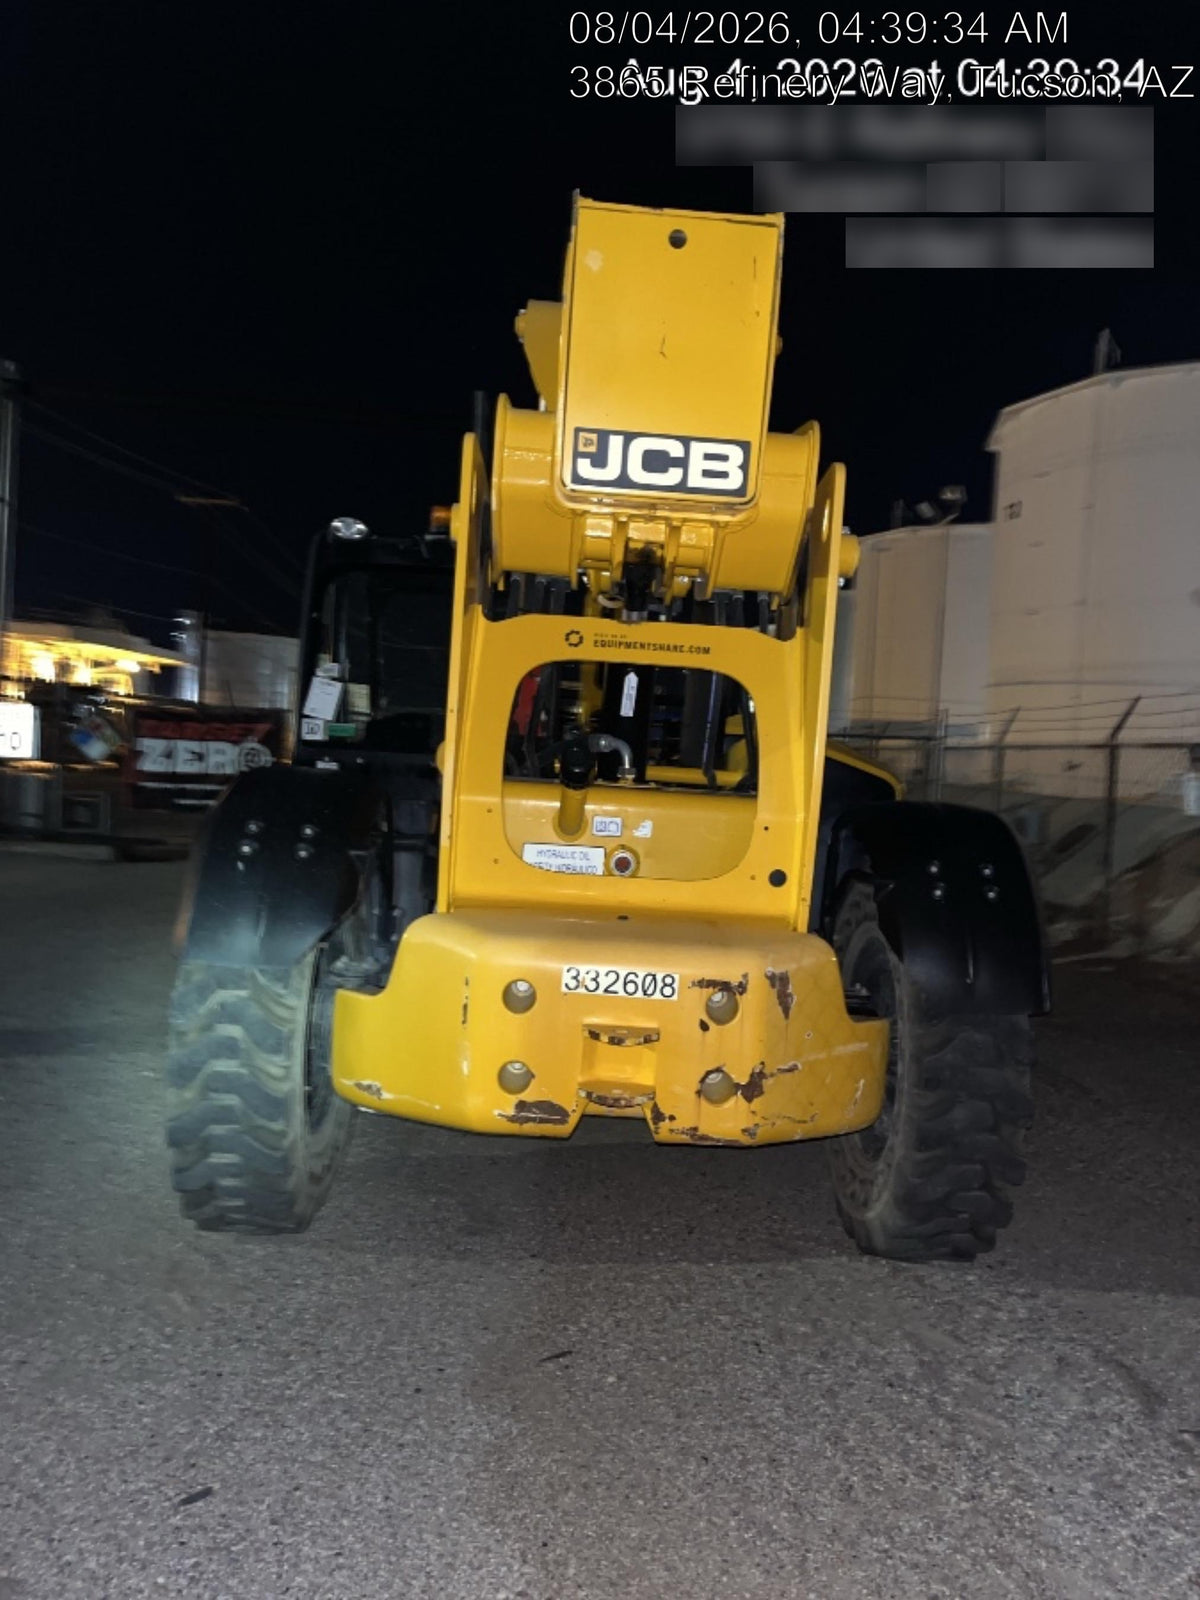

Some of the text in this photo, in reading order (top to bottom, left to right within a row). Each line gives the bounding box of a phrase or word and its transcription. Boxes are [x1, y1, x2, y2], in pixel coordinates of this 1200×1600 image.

[576, 435, 744, 490] JCB
[593, 640, 711, 655] EQUIPMENTSHARE.COM
[564, 966, 676, 998] 332608
